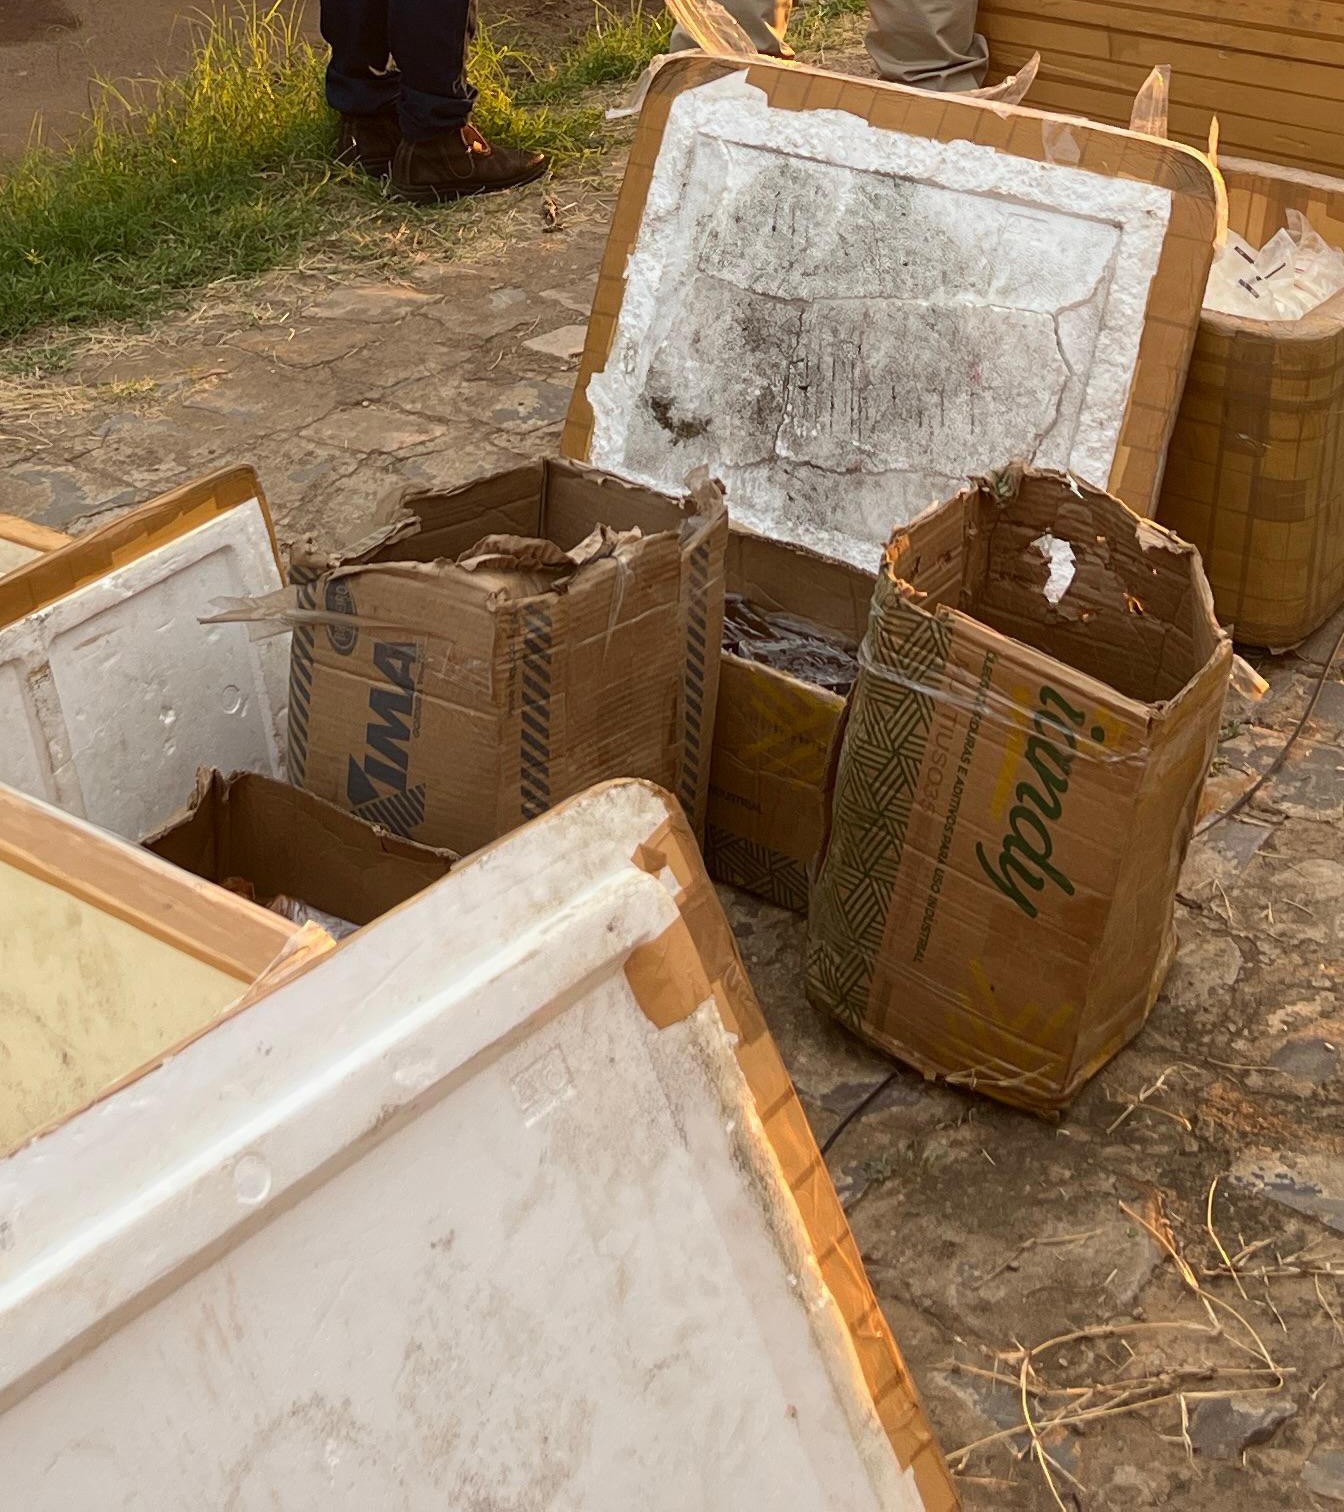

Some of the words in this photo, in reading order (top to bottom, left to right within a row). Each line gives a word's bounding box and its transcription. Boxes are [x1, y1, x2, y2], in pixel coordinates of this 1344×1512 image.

[944, 776, 964, 835] ADITIVOS
[937, 835, 952, 865] PARA
[931, 868, 945, 894] USO
[913, 895, 938, 964] INDUSTRIAL
